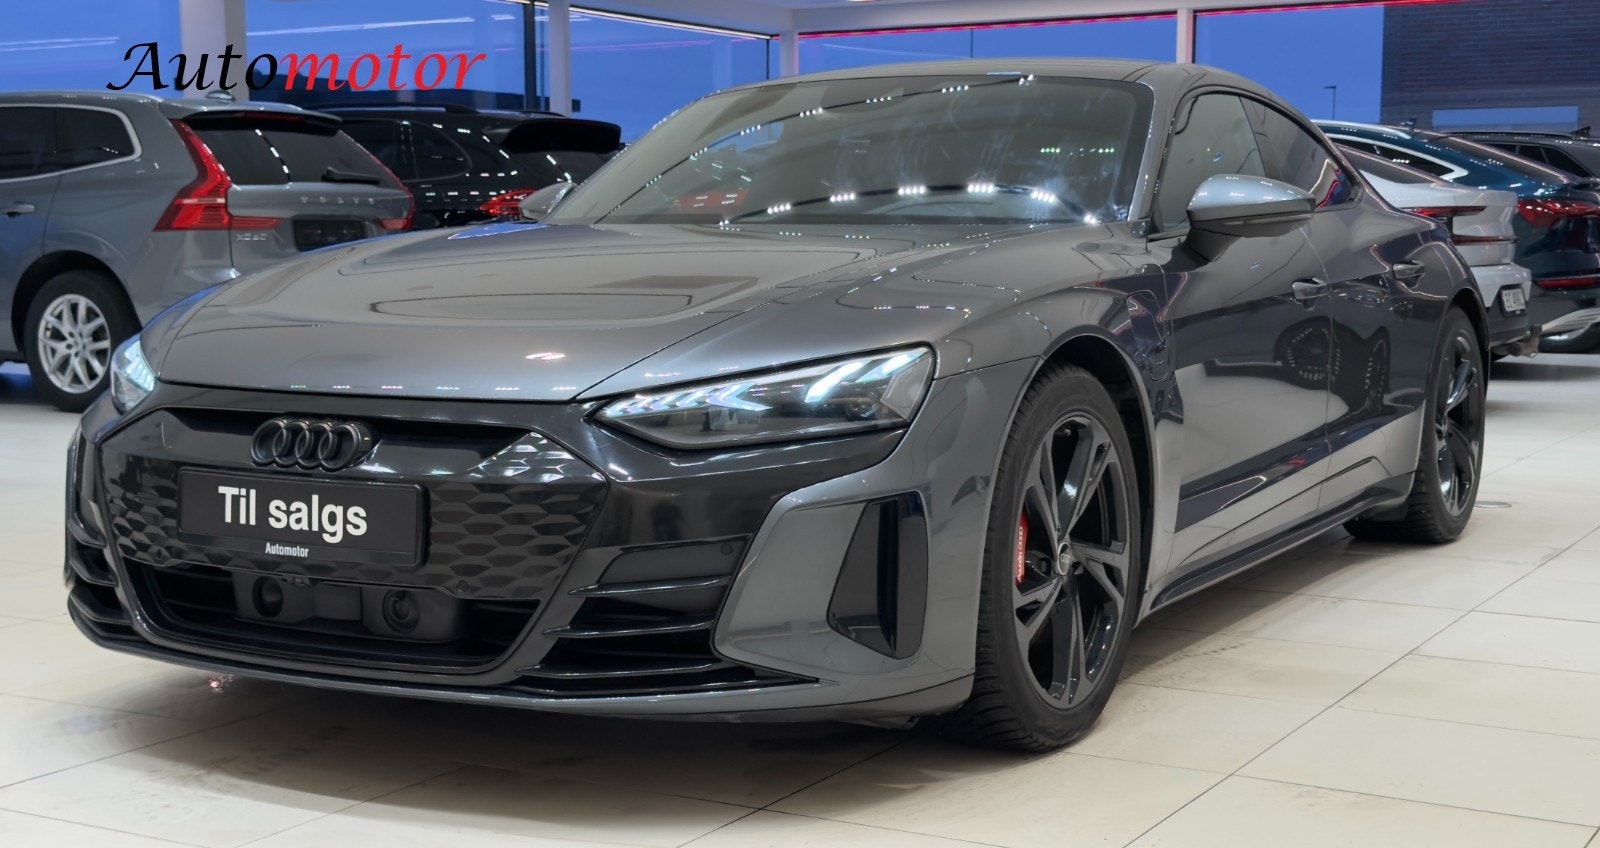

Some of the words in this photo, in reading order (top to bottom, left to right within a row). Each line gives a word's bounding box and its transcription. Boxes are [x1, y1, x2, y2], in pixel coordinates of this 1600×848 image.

[300, 196, 375, 205] VOLVO
[218, 486, 256, 525] Til
[268, 494, 368, 544] salgs
[265, 542, 309, 557] Automotor
